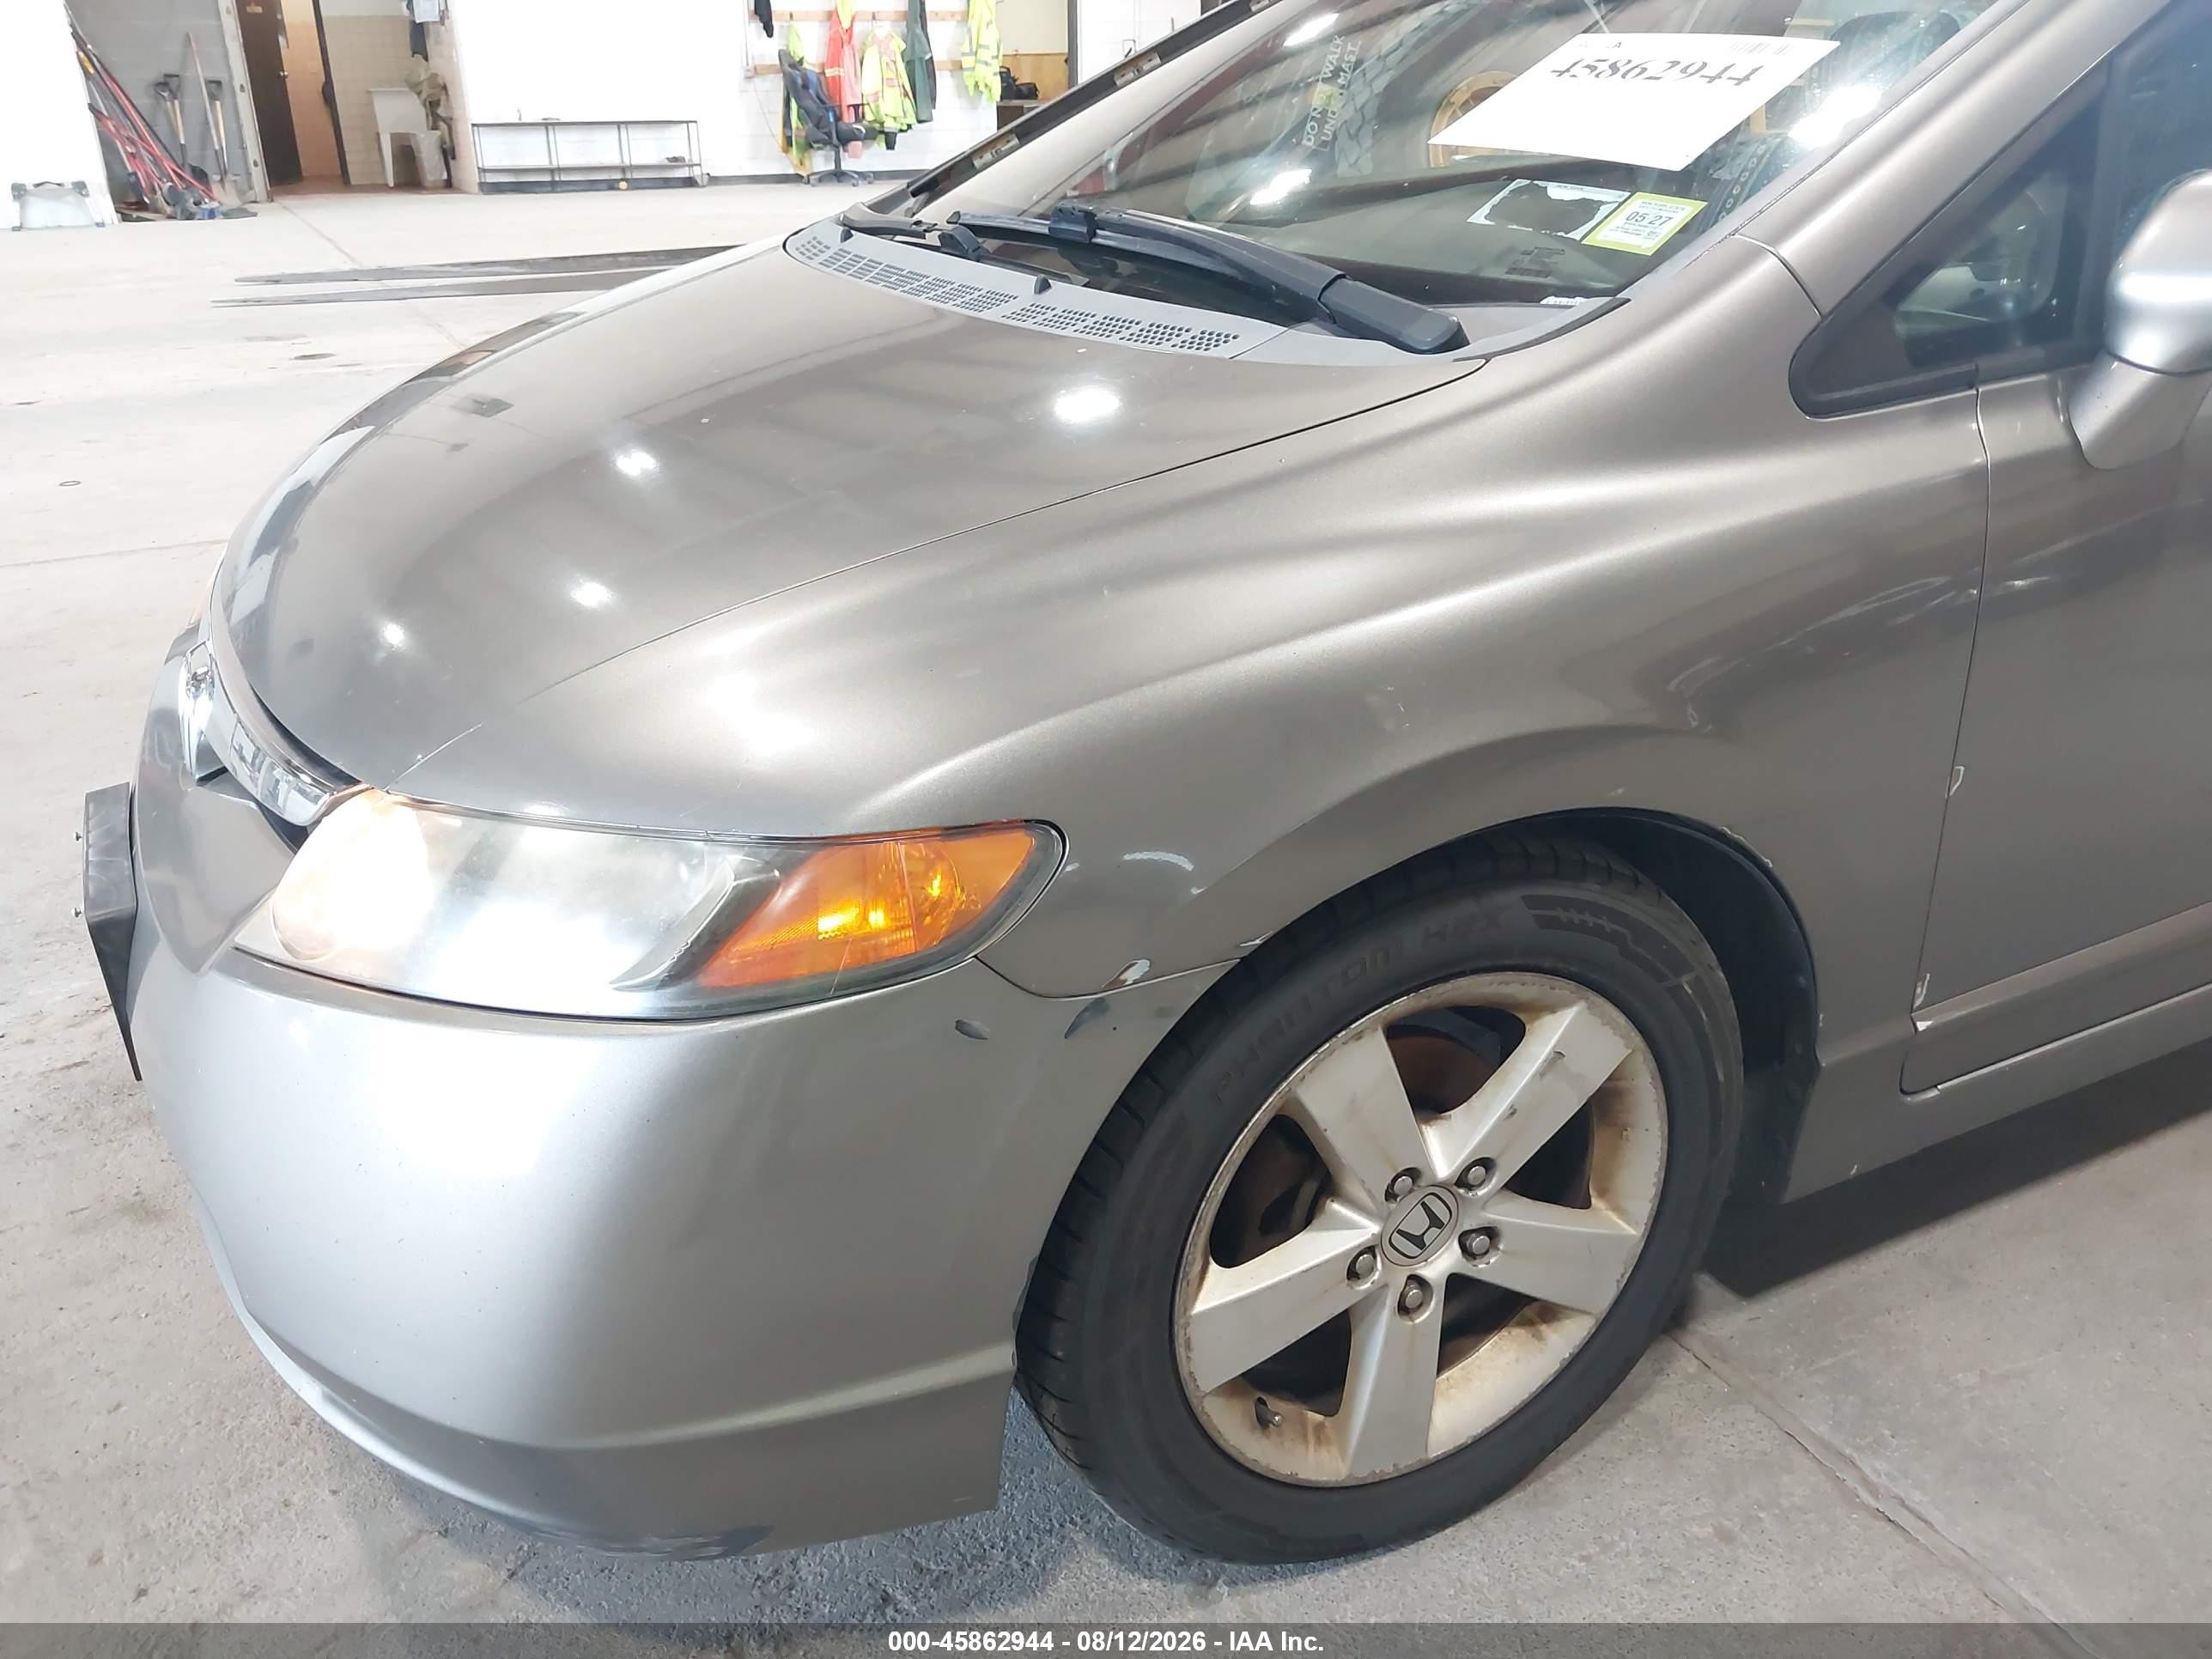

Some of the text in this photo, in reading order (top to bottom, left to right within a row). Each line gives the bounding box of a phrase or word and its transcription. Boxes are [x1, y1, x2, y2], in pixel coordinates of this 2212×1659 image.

[1322, 34, 1346, 79] WALK
[1337, 41, 1360, 85] MAST
[1549, 58, 1765, 87] 45862944
